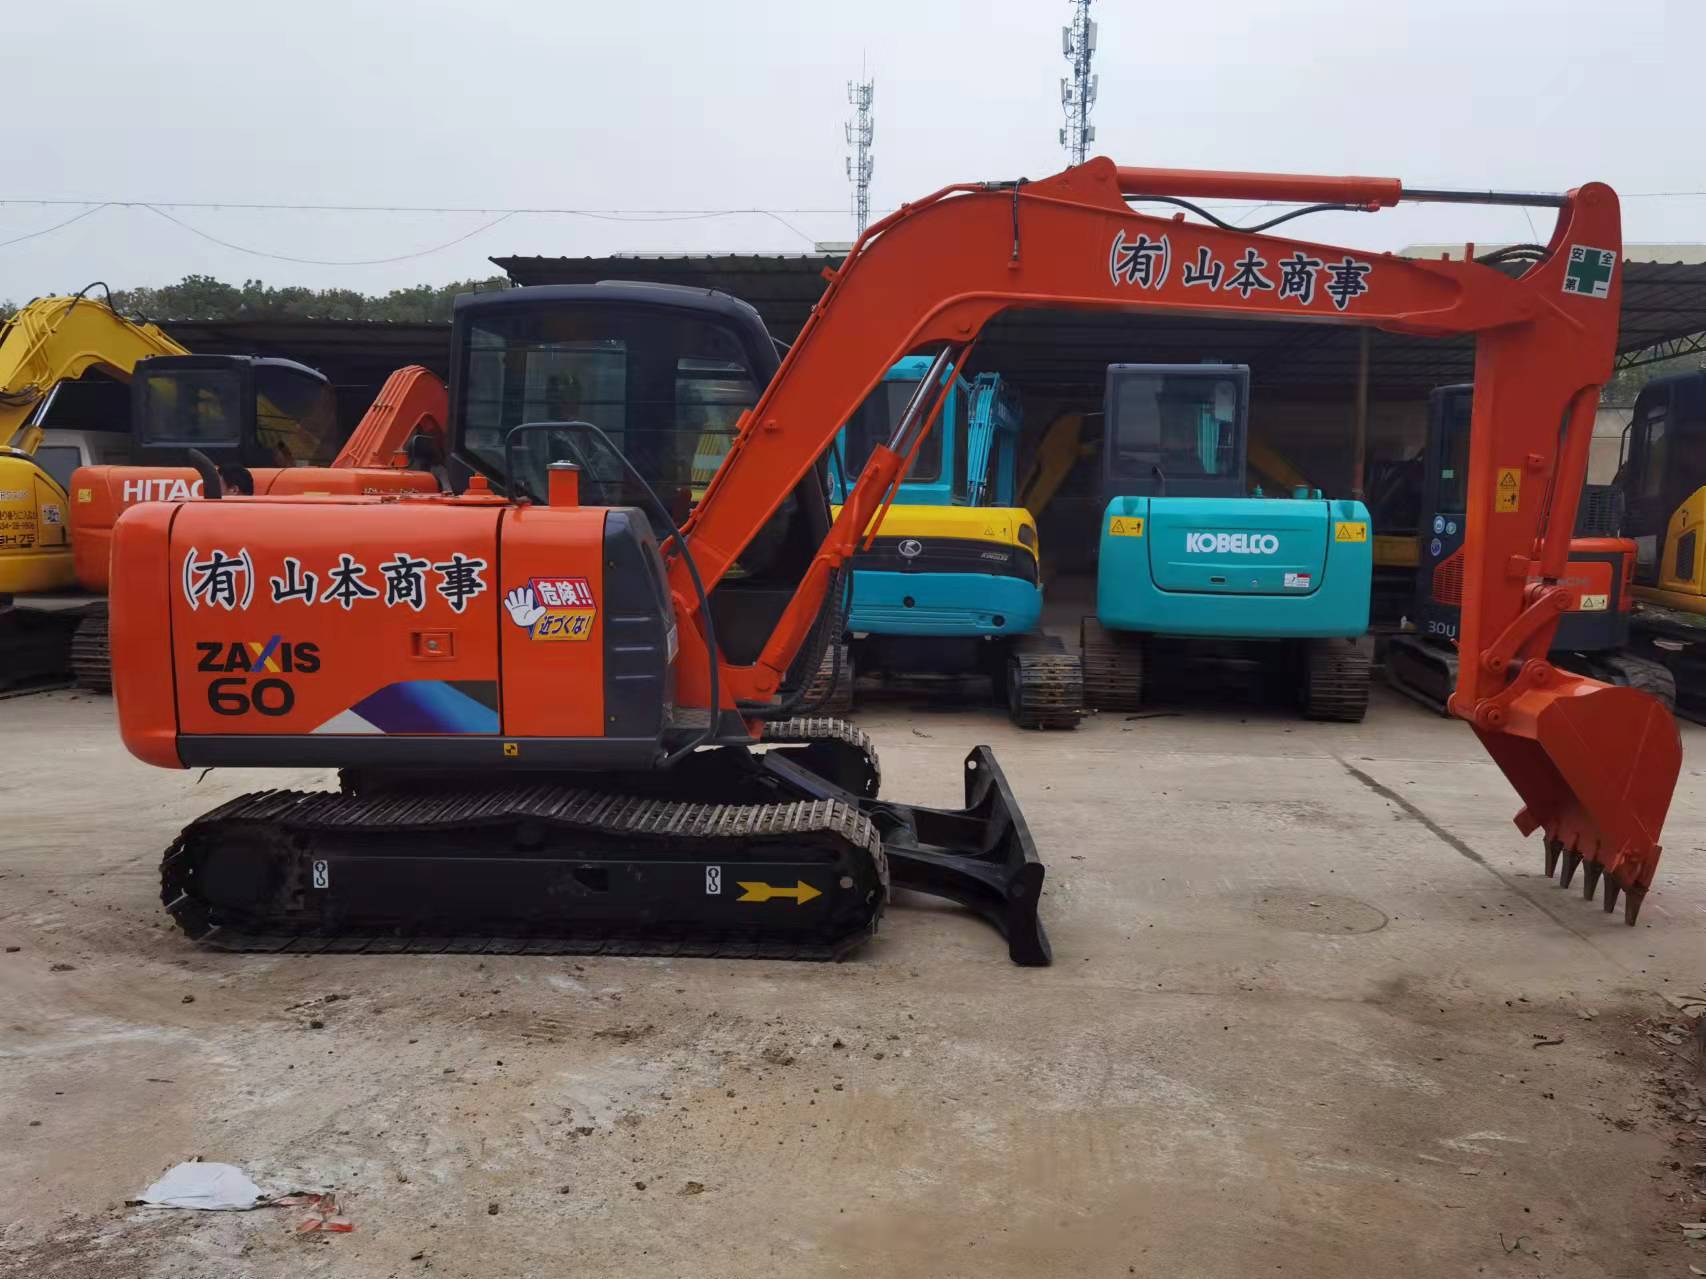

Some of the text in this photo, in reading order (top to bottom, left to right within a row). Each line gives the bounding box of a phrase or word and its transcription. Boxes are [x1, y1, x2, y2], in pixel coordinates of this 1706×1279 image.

[1110, 229, 1371, 311] (有)山本商事
[1186, 532, 1280, 555] KOBELCO
[183, 546, 487, 613] (有)山本商事
[196, 635, 321, 673] ZAXIS
[207, 677, 295, 717] 60
